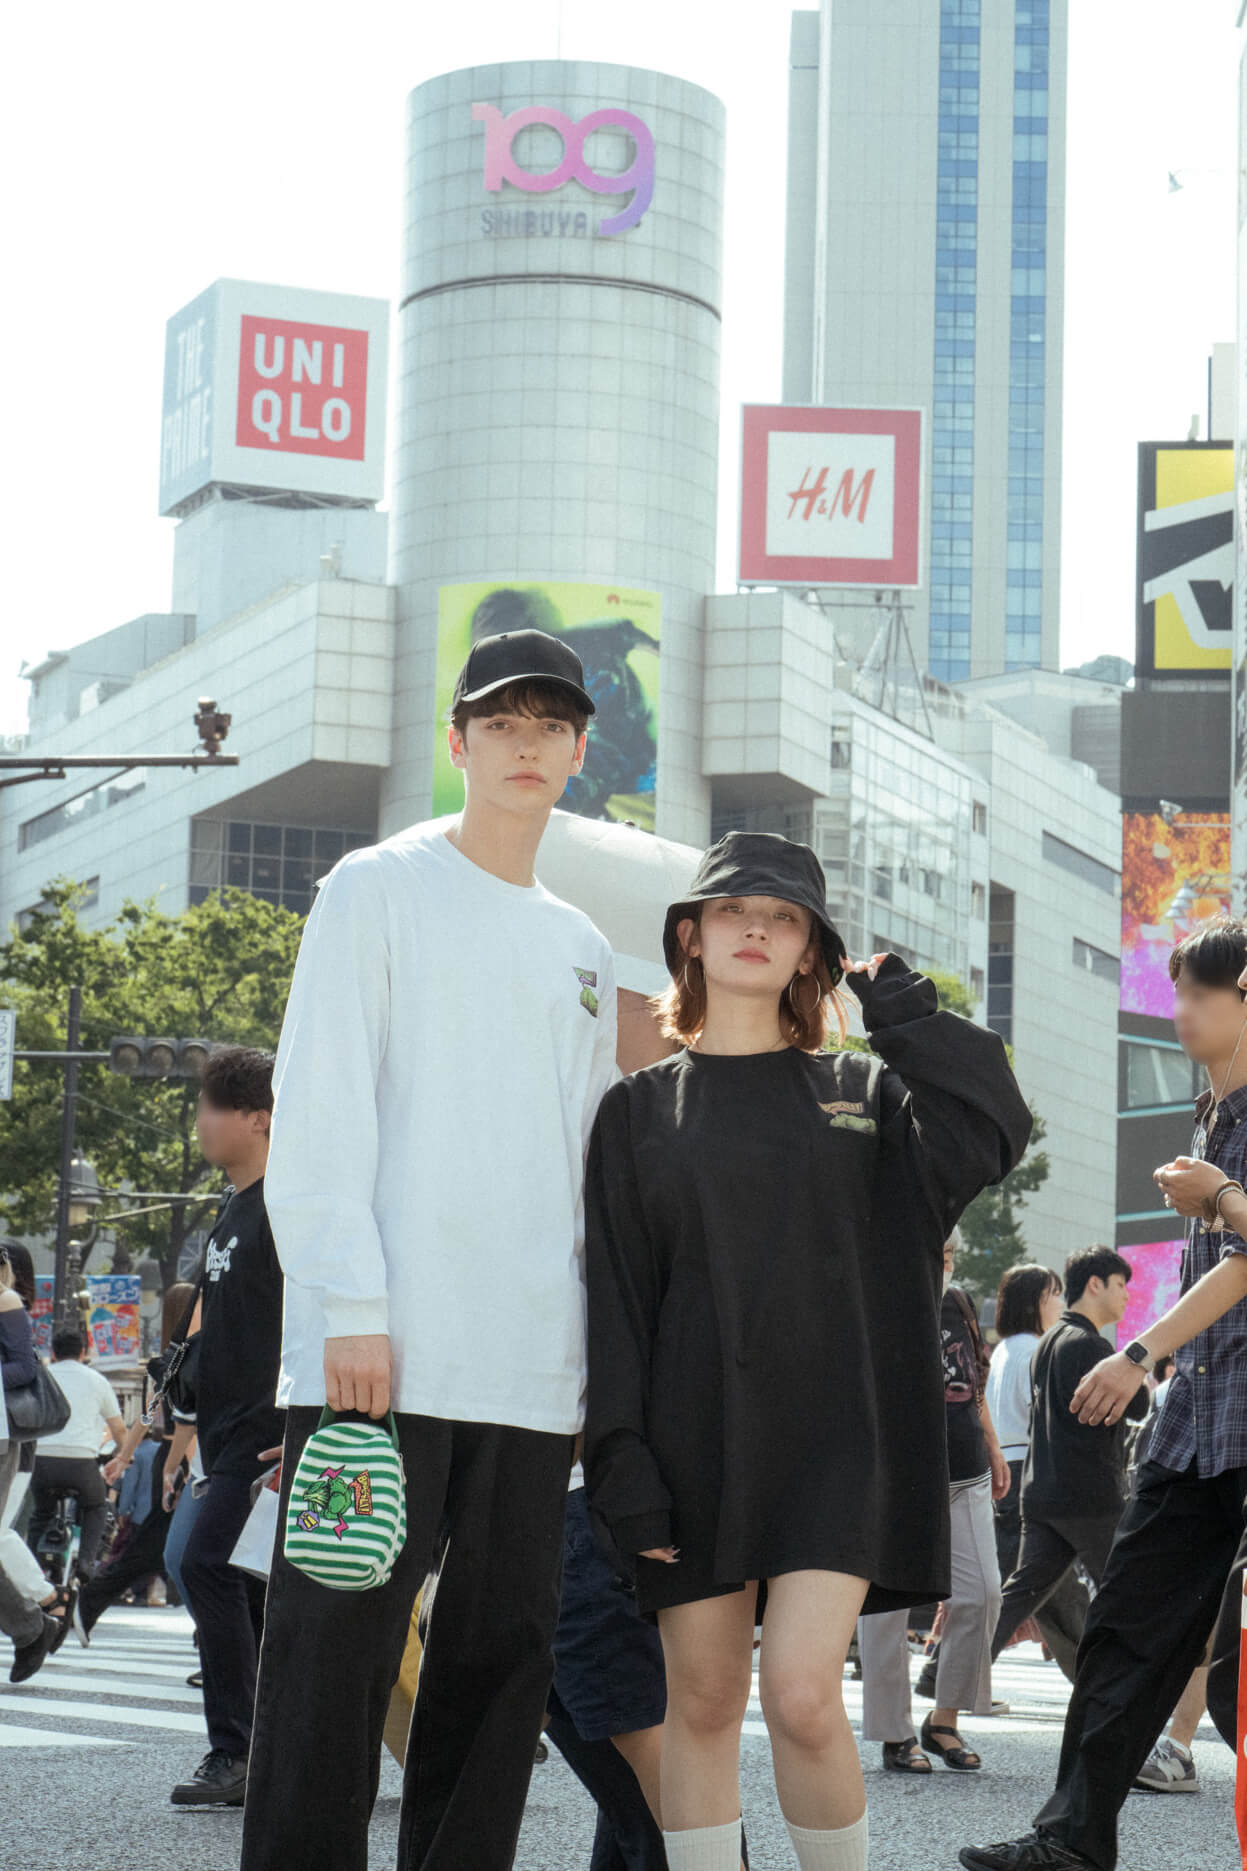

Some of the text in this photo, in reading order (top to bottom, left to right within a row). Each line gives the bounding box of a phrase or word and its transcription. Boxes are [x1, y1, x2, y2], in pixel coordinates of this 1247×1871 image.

[471, 102, 656, 237] 109
[480, 208, 589, 237] SHIBUYA
[176, 317, 206, 401] THE
[254, 332, 345, 388] UNI
[251, 388, 352, 443] QLO
[786, 466, 876, 524] H&M
